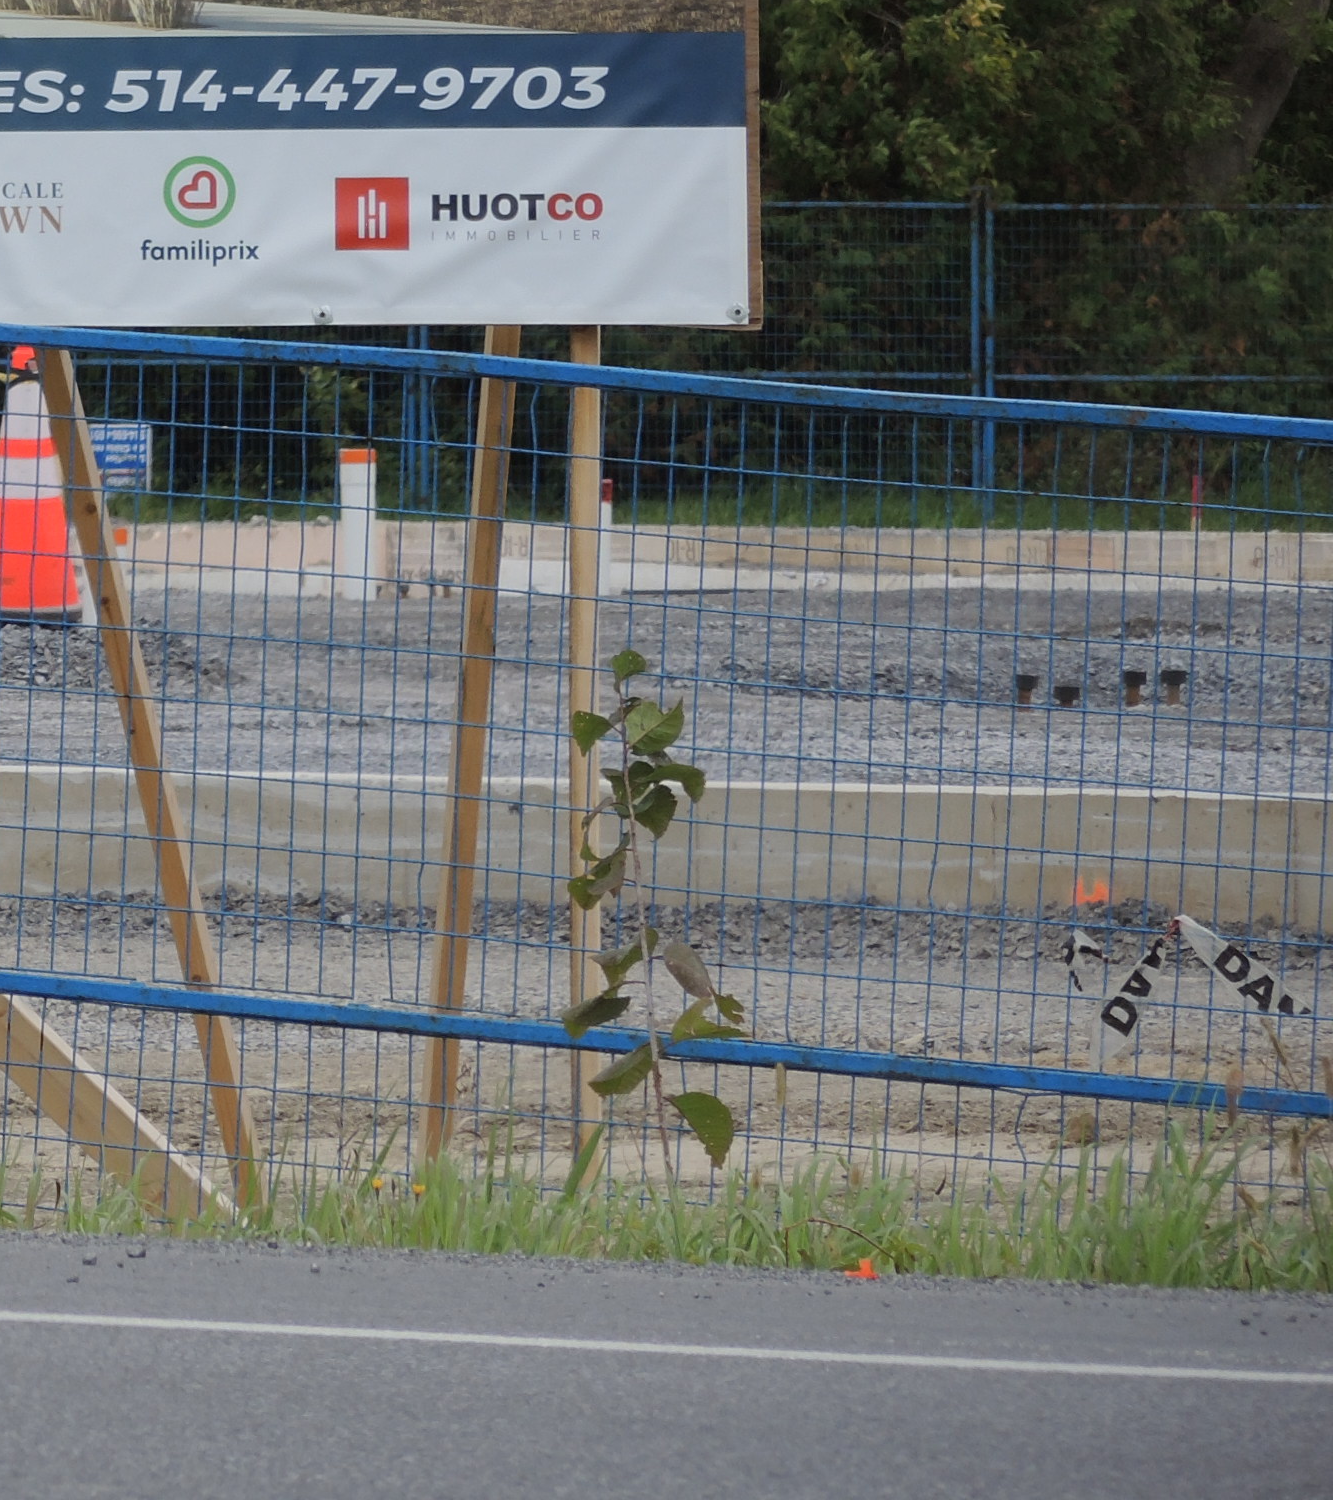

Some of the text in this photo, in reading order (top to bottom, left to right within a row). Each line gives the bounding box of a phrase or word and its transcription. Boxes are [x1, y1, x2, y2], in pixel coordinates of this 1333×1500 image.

[103, 66, 611, 113] 514-447-9703
[431, 193, 604, 221] HUOTCO
[431, 229, 601, 242] IMMOBILIER
[140, 239, 260, 267] familiprix
